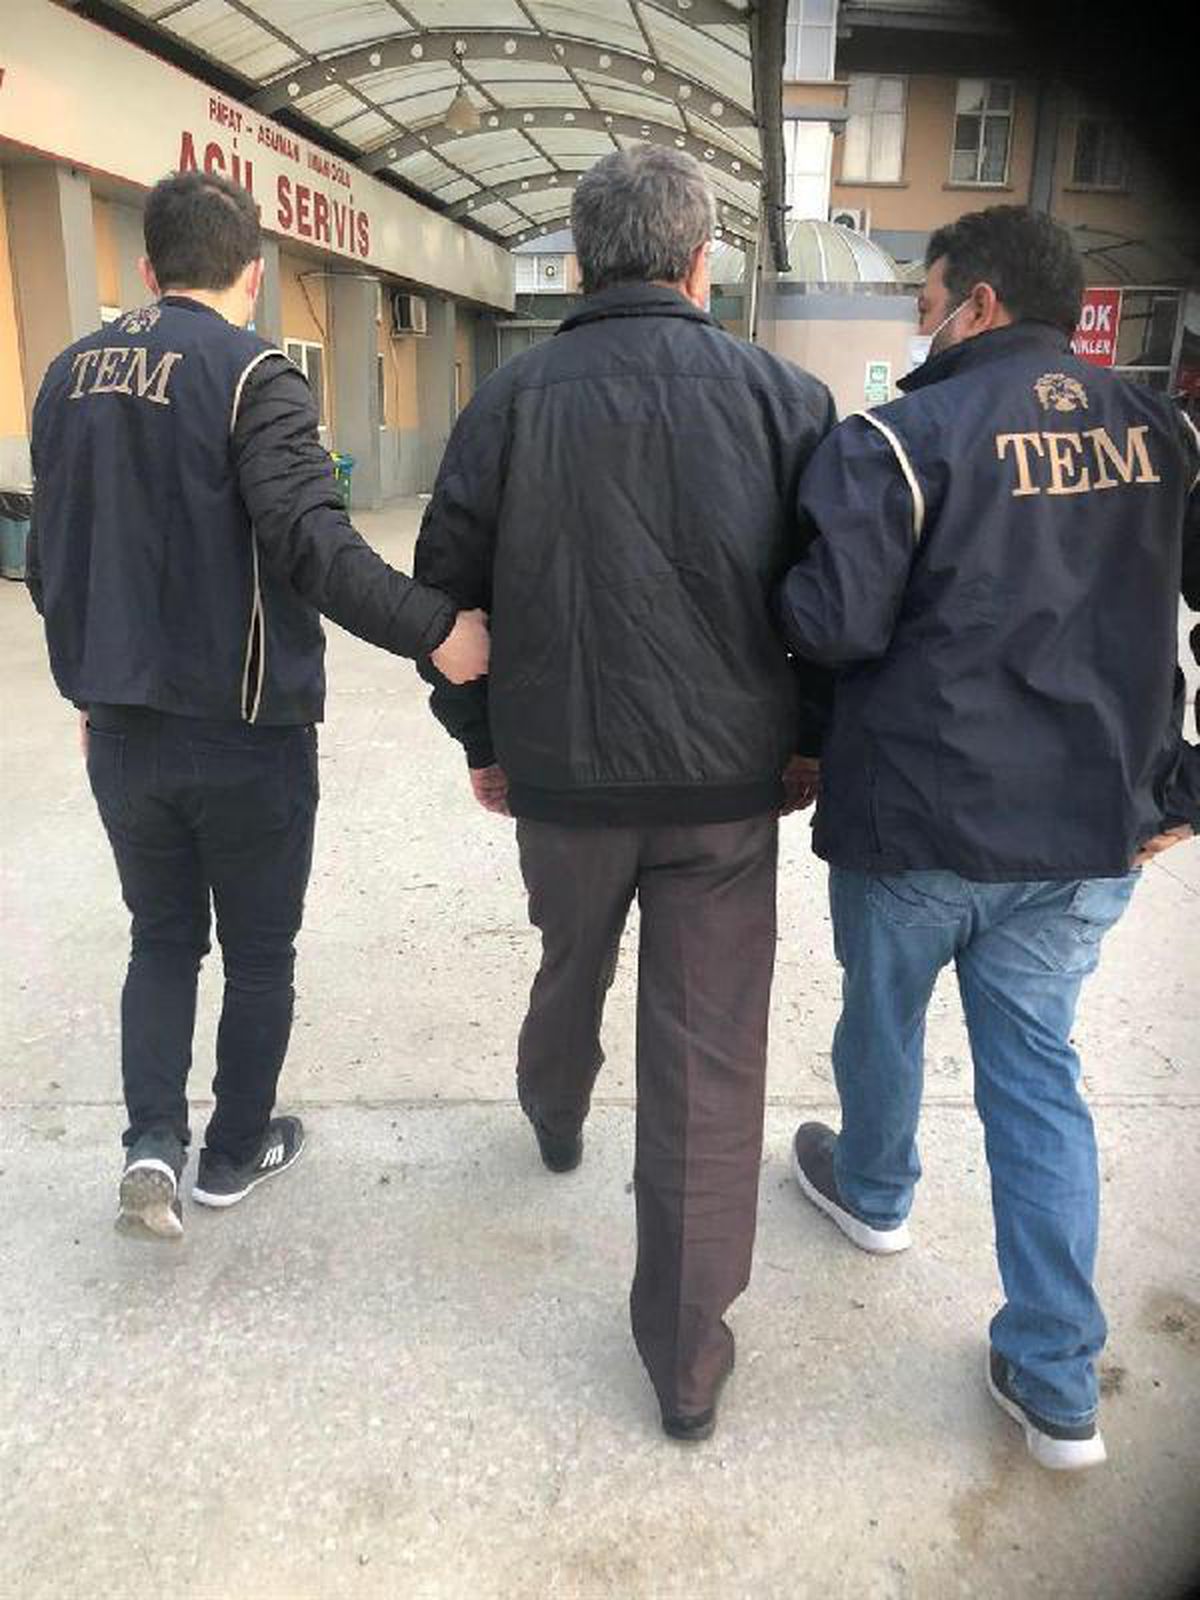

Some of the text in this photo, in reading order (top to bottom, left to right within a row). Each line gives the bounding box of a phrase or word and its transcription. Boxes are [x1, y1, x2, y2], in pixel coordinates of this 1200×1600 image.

[257, 125, 300, 163] ASUMAN
[277, 174, 369, 257] SERVİS
[1075, 304, 1112, 331] OK
[68, 347, 184, 405] TEM
[995, 424, 1161, 497] TEM
